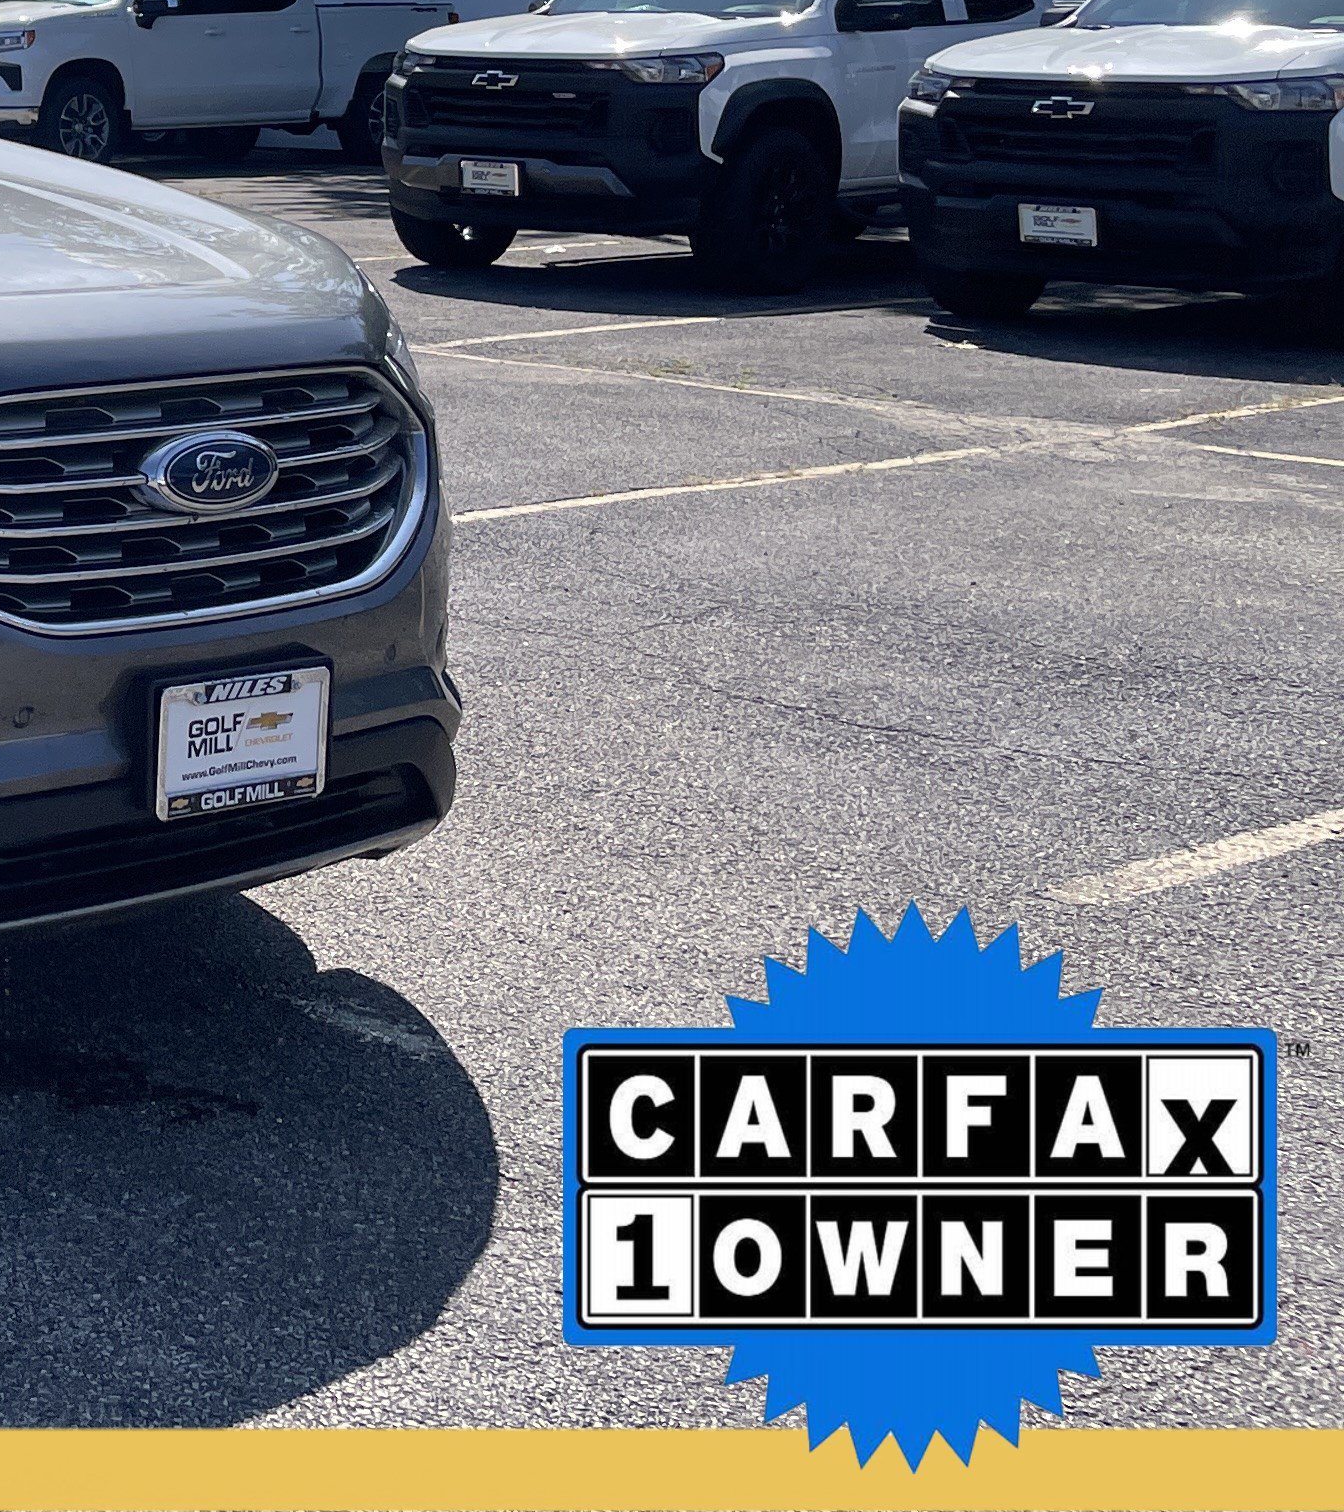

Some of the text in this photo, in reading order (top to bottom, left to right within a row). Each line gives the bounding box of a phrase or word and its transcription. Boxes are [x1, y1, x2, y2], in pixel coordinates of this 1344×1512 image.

[191, 450, 255, 494] Ford
[209, 675, 289, 702] NILES
[188, 712, 245, 739] GOLF
[187, 734, 234, 759] MILL
[181, 755, 297, 781] www.GolfMillChevy.com
[200, 782, 285, 810] GOLF MILL
